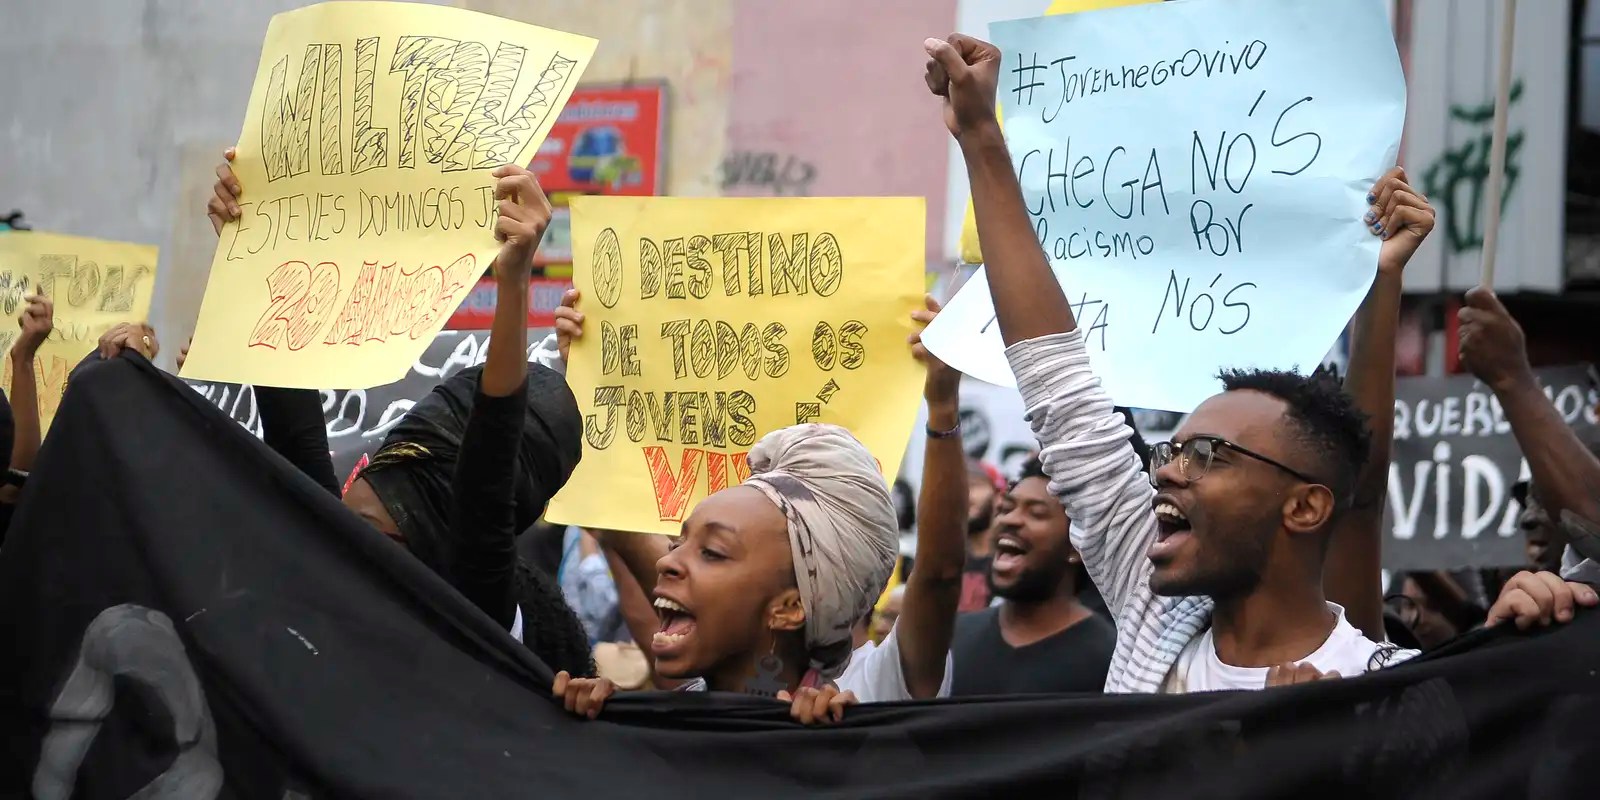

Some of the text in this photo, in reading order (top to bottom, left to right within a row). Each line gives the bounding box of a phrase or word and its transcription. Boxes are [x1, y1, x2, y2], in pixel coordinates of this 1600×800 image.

[261, 35, 578, 183] WILTON
[1191, 90, 1322, 194] NÓS
[226, 193, 346, 262] ESTEVES
[358, 186, 465, 240] DOMINGOS
[248, 260, 341, 351] 20
[592, 227, 623, 309] O
[640, 231, 842, 300] DESTINO
[1152, 269, 1257, 335] NÓS
[600, 320, 642, 378] DE
[660, 318, 791, 381] TODOS
[811, 319, 869, 371] OS
[585, 385, 756, 450] JOVENS
